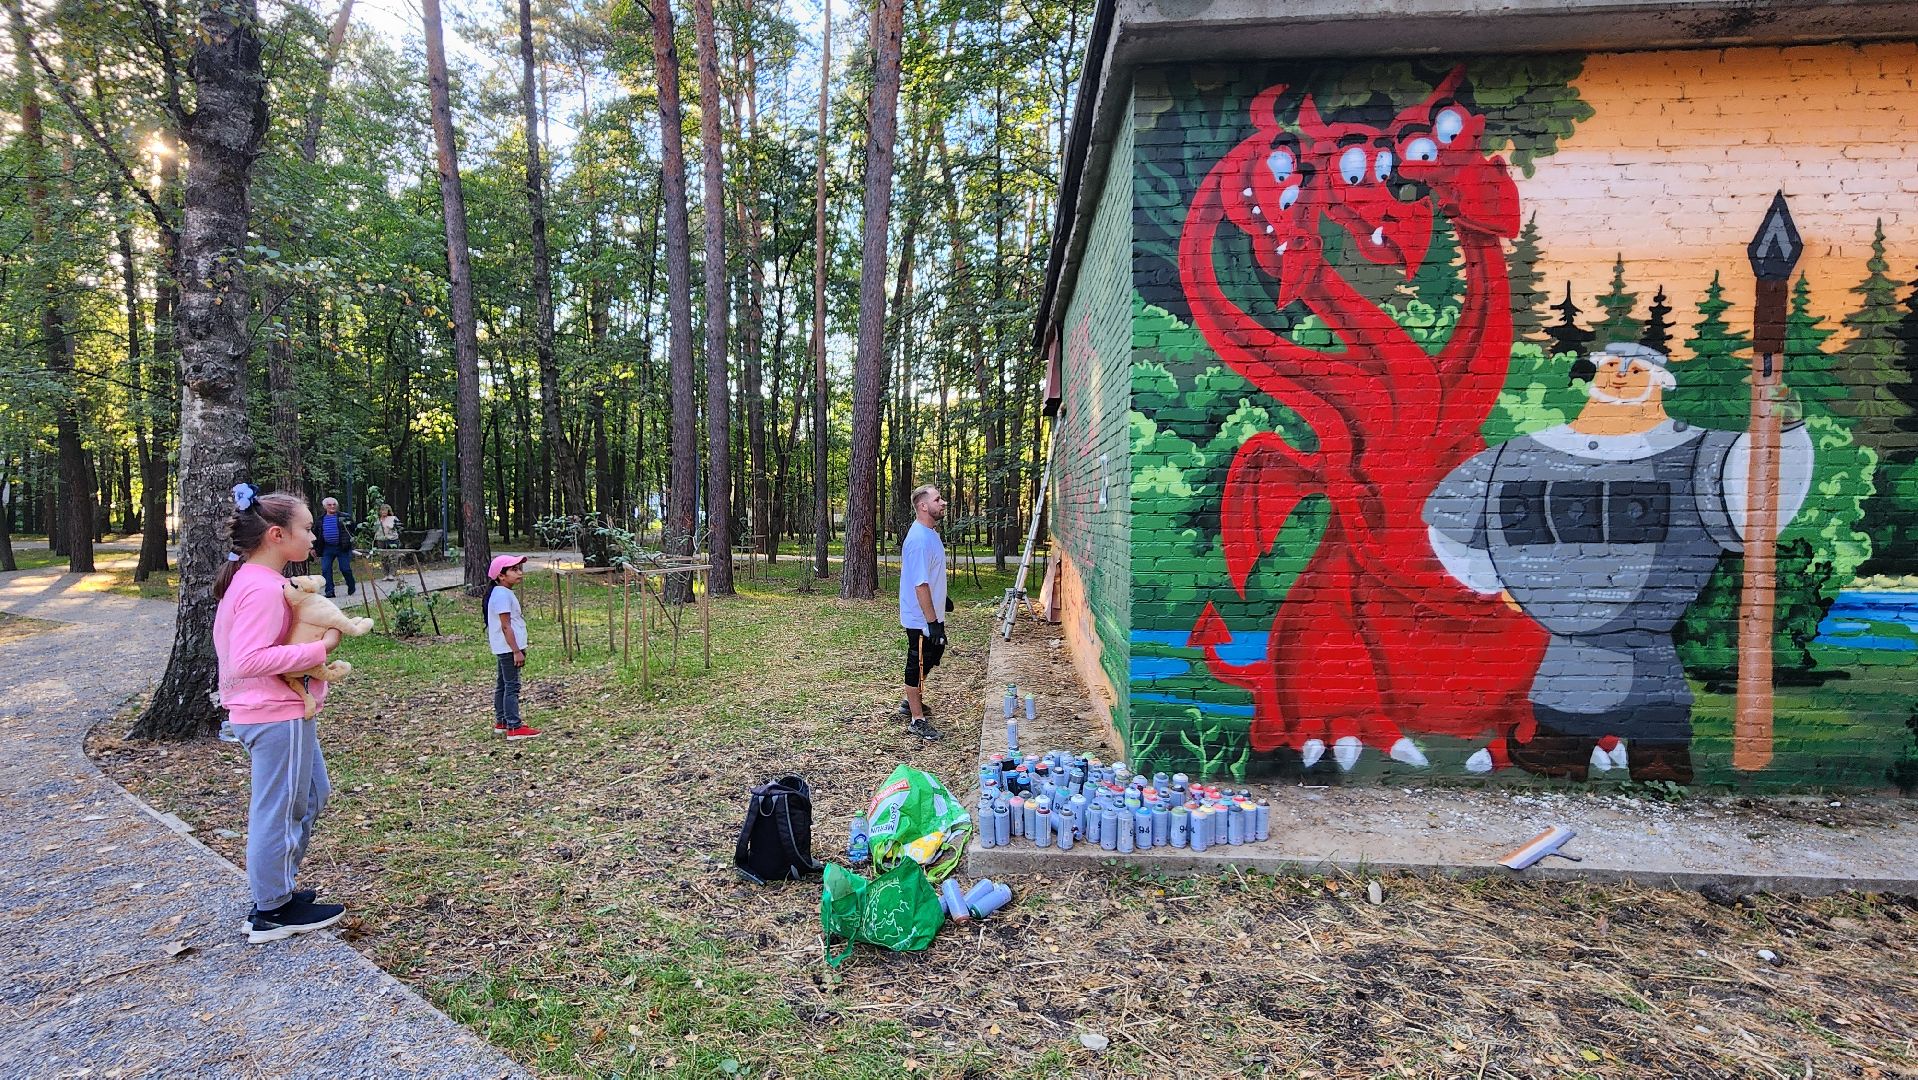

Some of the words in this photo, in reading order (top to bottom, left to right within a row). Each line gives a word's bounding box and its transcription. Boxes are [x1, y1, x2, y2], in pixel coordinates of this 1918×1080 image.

[890, 802, 899, 825] LEROY
[870, 824, 895, 834] MERLIN
[1138, 825, 1150, 834] 94
